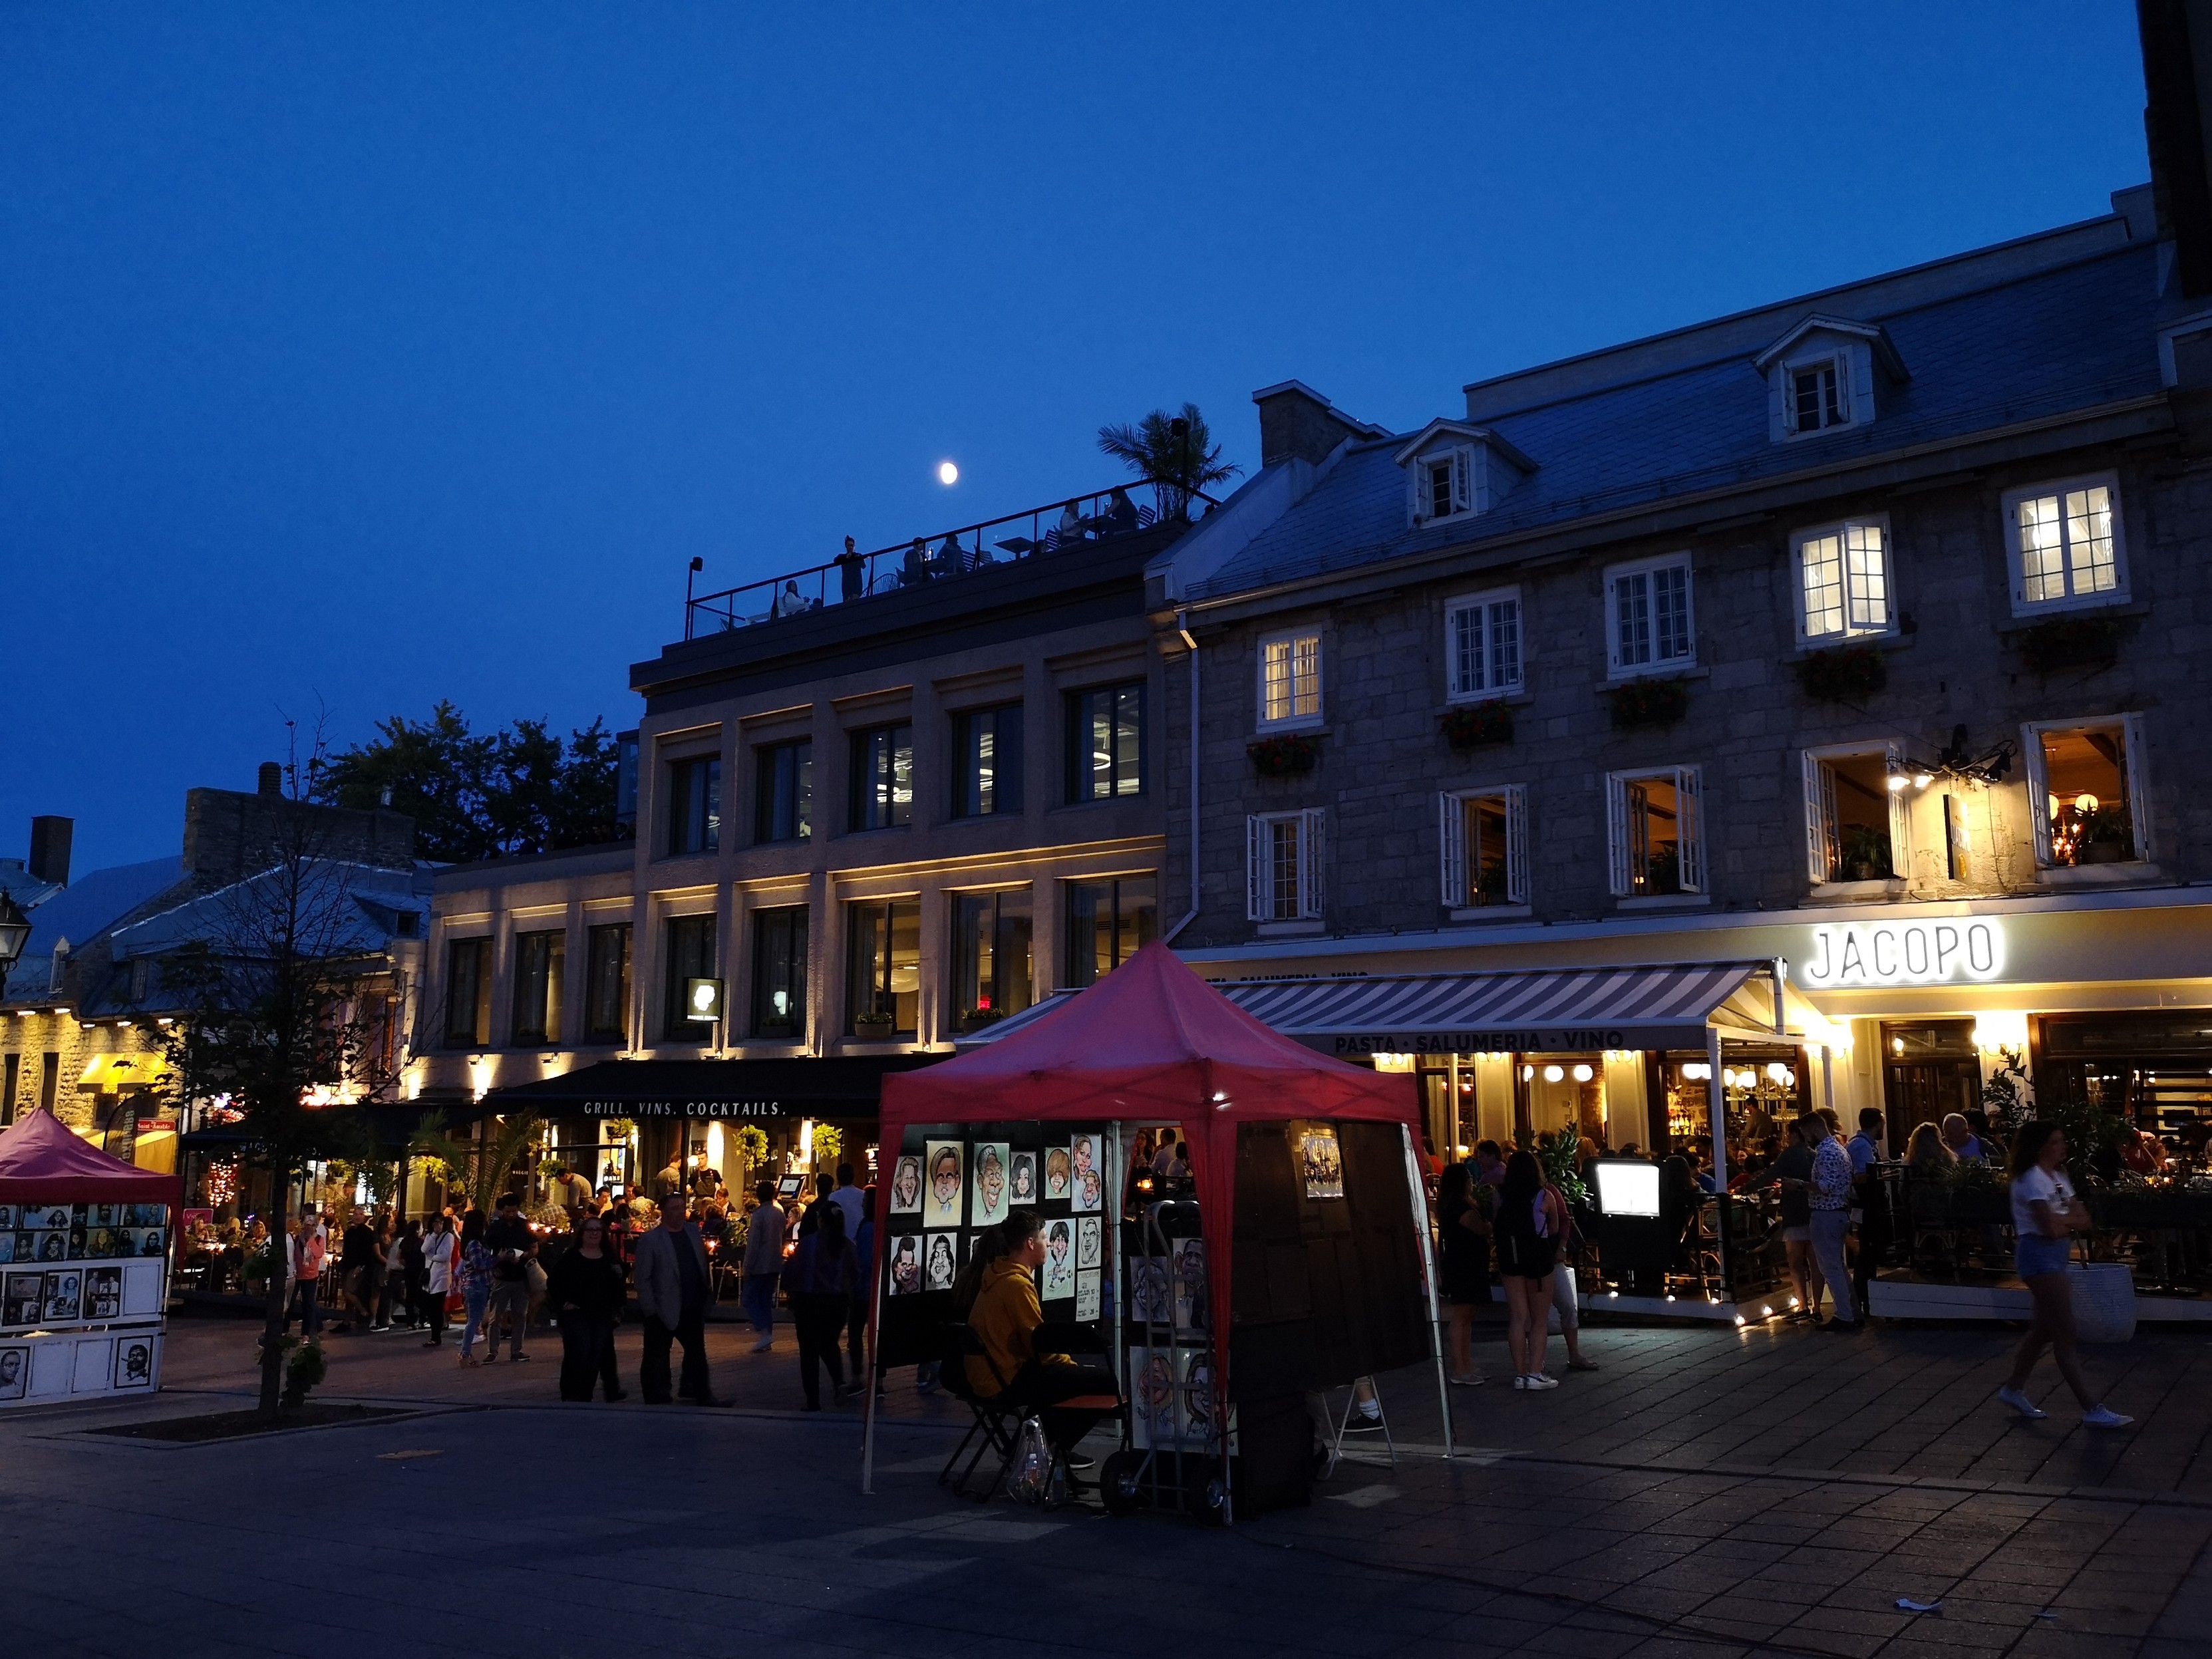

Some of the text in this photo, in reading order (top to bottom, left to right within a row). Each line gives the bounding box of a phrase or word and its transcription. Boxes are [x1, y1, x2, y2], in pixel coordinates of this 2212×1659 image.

[1810, 923, 1993, 979] JACOPO
[1335, 1030, 1624, 1052] PASTA SALUMERIA VINO
[583, 1101, 786, 1116] GRILL. VINS. COCKTAILS.
